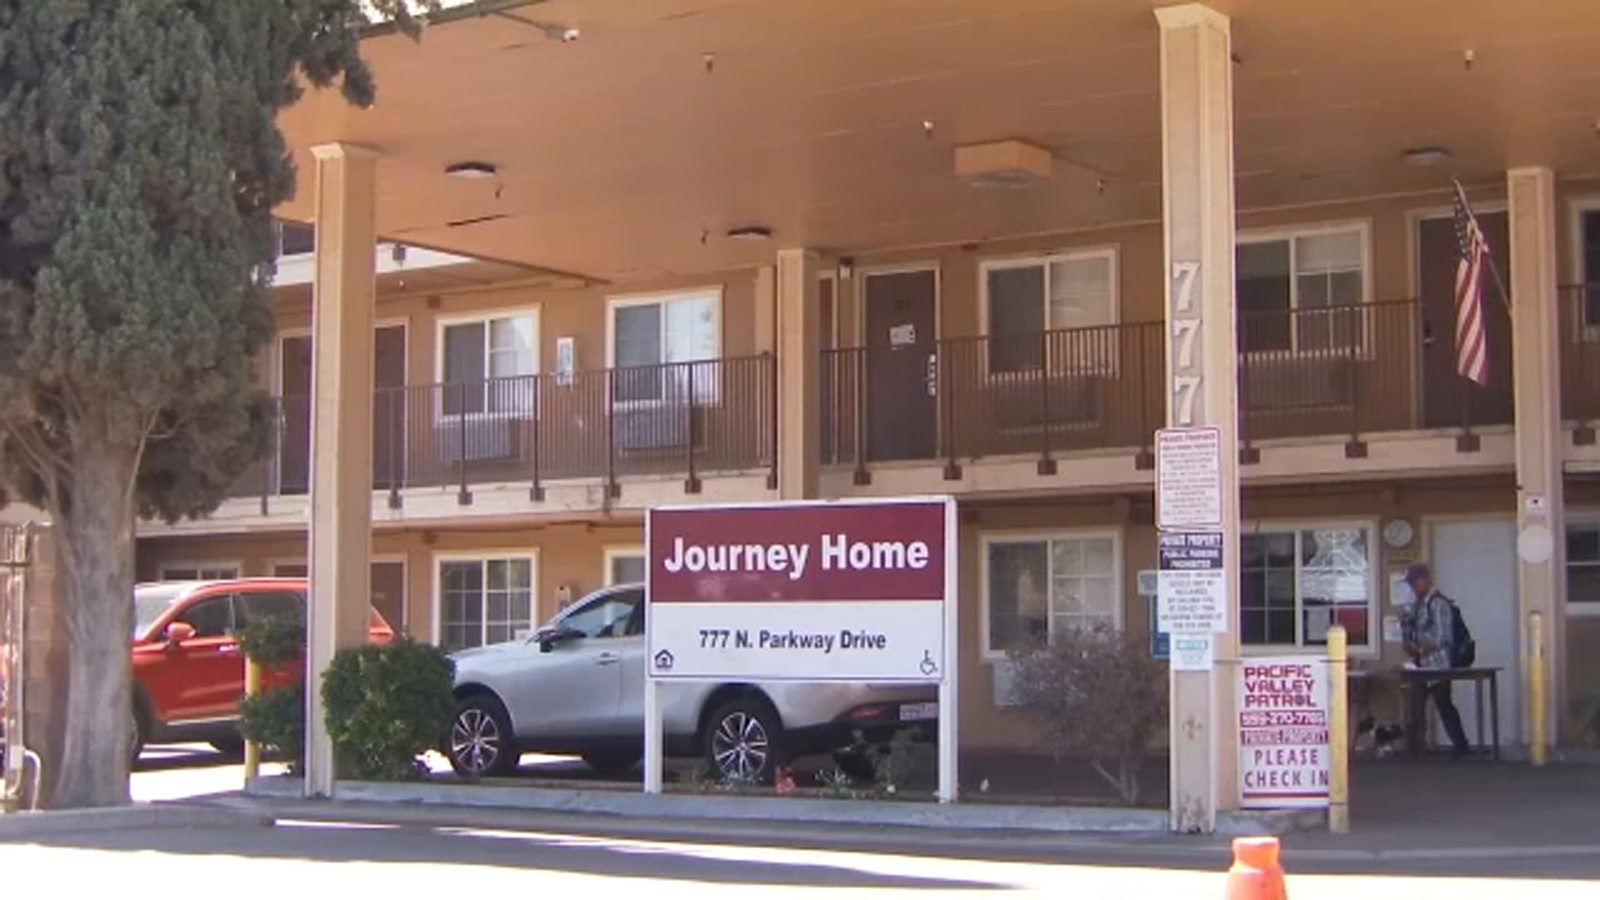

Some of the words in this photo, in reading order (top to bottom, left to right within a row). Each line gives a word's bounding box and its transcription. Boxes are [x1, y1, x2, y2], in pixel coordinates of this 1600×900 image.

[1172, 261, 1202, 425] 777
[664, 537, 809, 579] Journey
[821, 534, 929, 570] Home
[699, 630, 730, 648] 777
[735, 630, 753, 648] N.
[759, 629, 835, 654] Parkway
[841, 629, 886, 649] Drive
[1244, 664, 1312, 679] PACIFIC
[1244, 680, 1315, 693] VALLEY
[1244, 694, 1317, 708] PATROL
[1254, 749, 1318, 766] PLEASE
[1244, 770, 1301, 788] CHECK
[1311, 769, 1328, 786] IN
